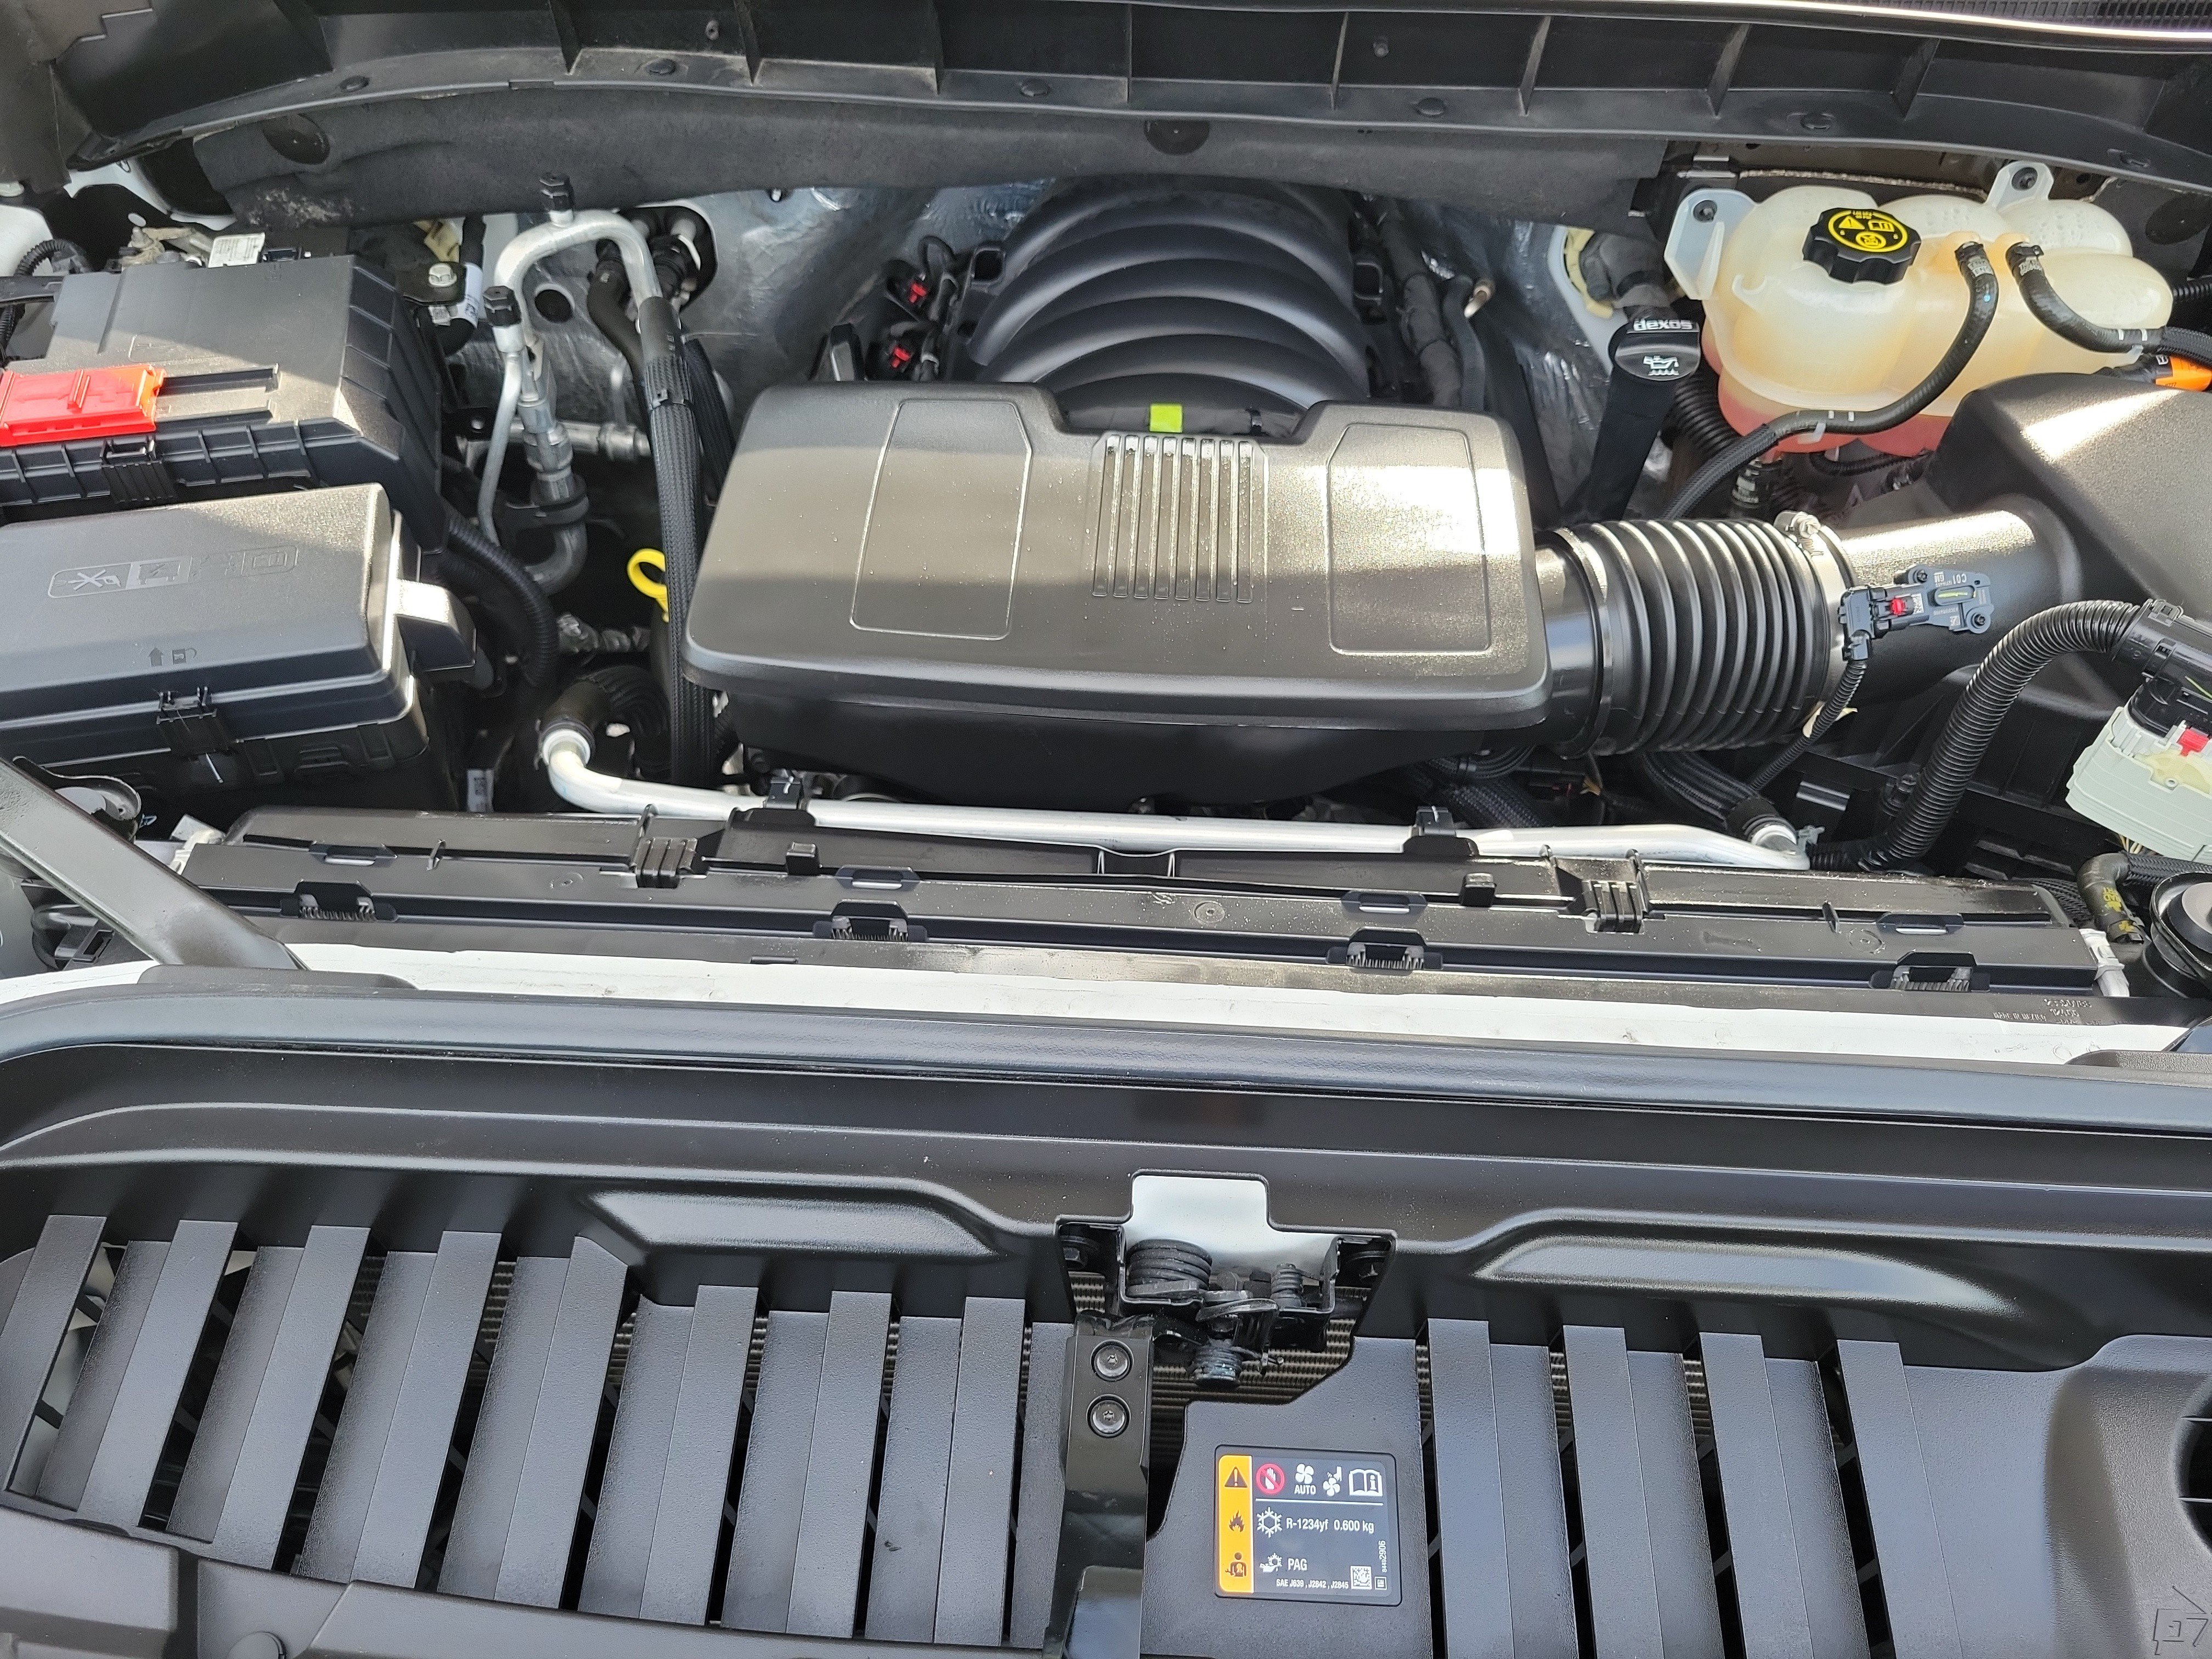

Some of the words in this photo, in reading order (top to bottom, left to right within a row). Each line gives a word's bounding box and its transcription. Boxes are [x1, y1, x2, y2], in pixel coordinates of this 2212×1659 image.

[1633, 318, 1693, 331] dexos
[1294, 1485, 1316, 1496] AUTO
[1286, 1517, 1329, 1533] R-1234yf
[1334, 1520, 1361, 1532] 0.600
[1362, 1520, 1375, 1534] kg
[1288, 1558, 1308, 1571] PAG
[1276, 1579, 1288, 1587] SAE
[1331, 1581, 1349, 1589] J2845
